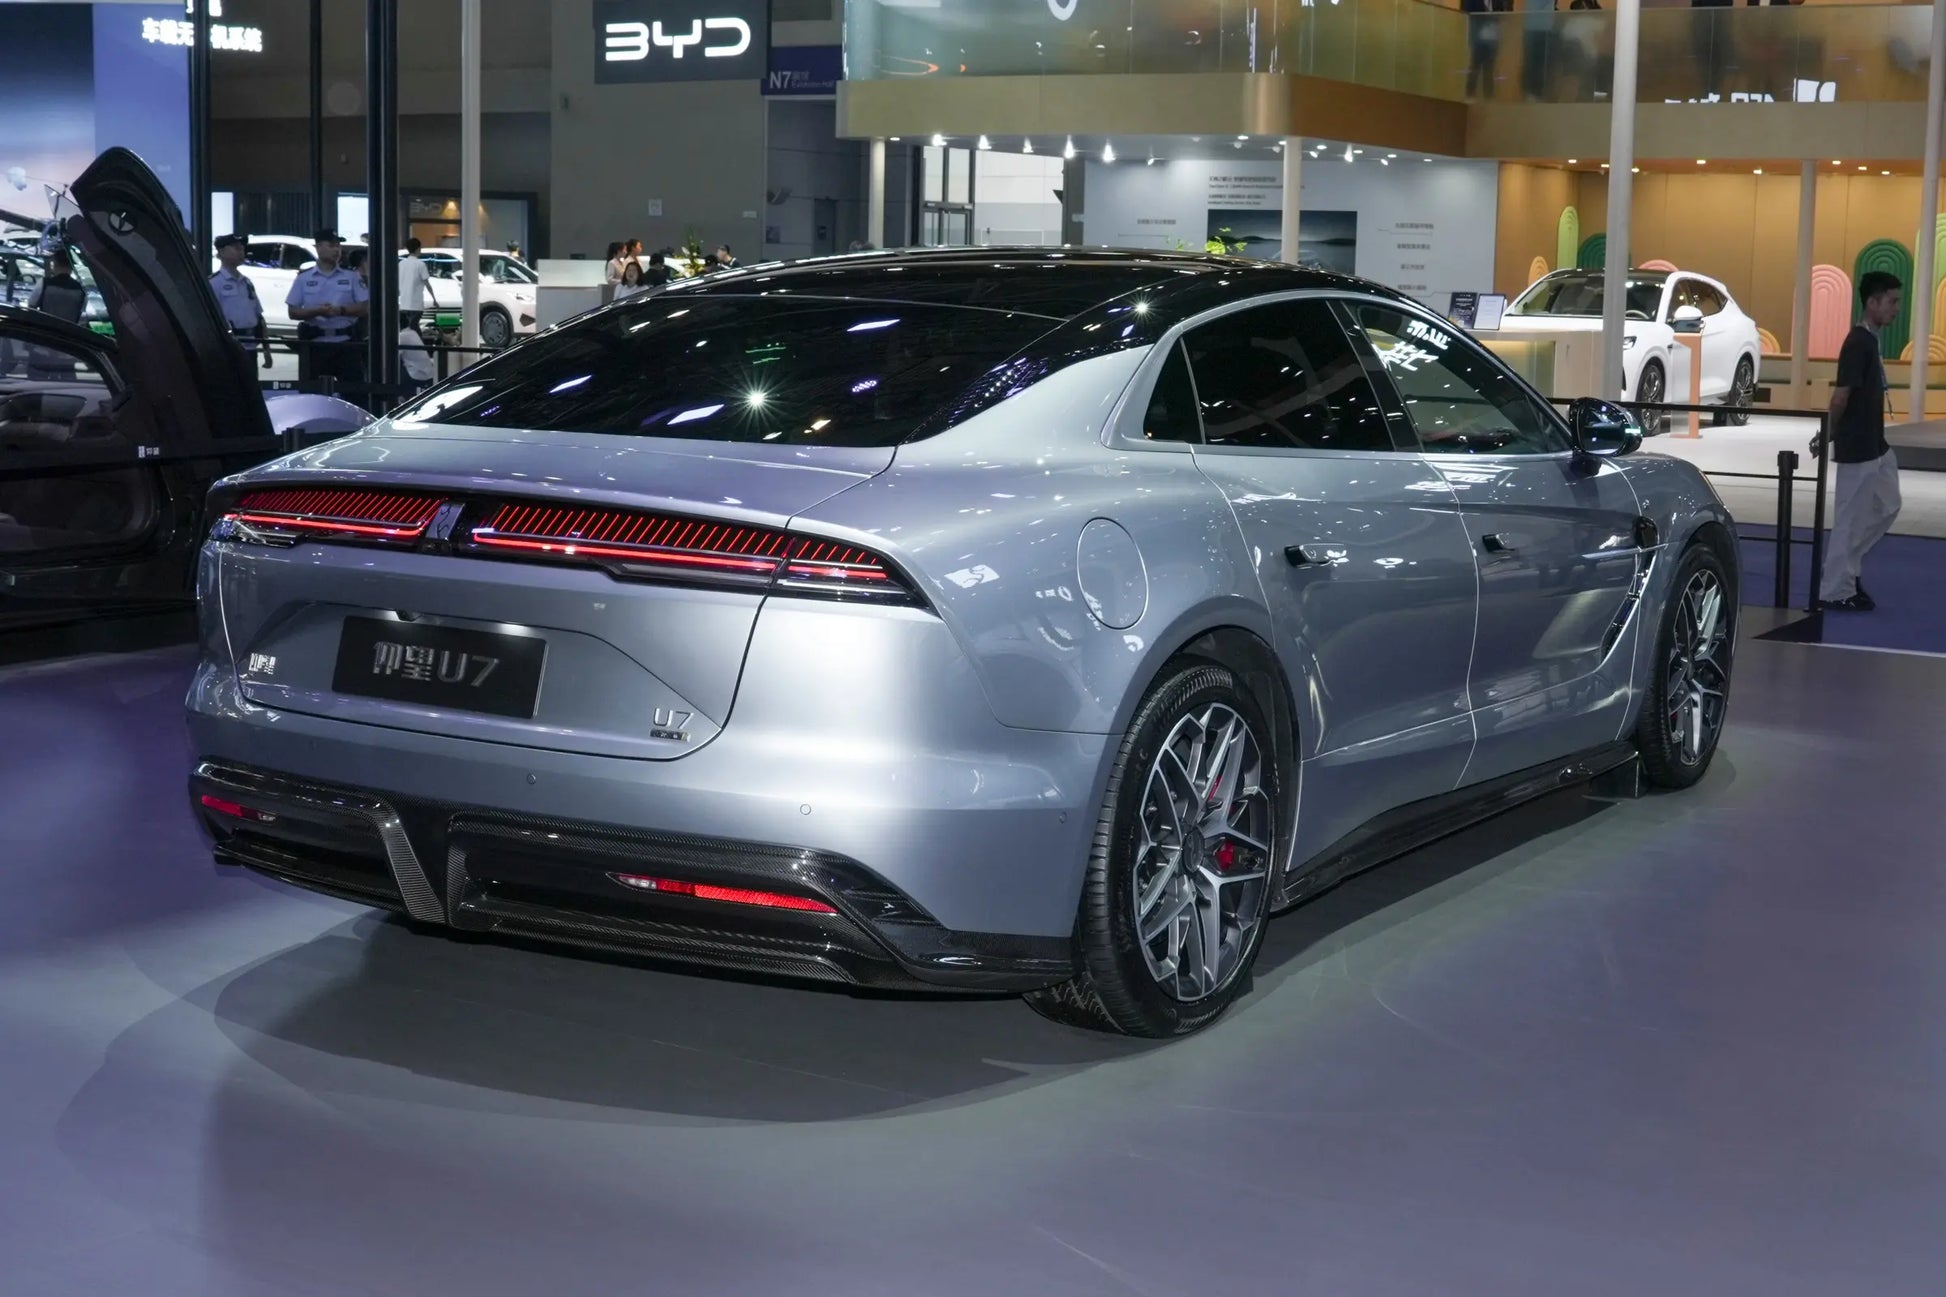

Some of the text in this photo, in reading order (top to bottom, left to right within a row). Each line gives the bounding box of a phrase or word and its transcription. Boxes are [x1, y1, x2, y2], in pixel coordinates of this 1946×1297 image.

[605, 17, 751, 61] BYD
[769, 71, 792, 89] N7
[653, 707, 694, 730] U7
